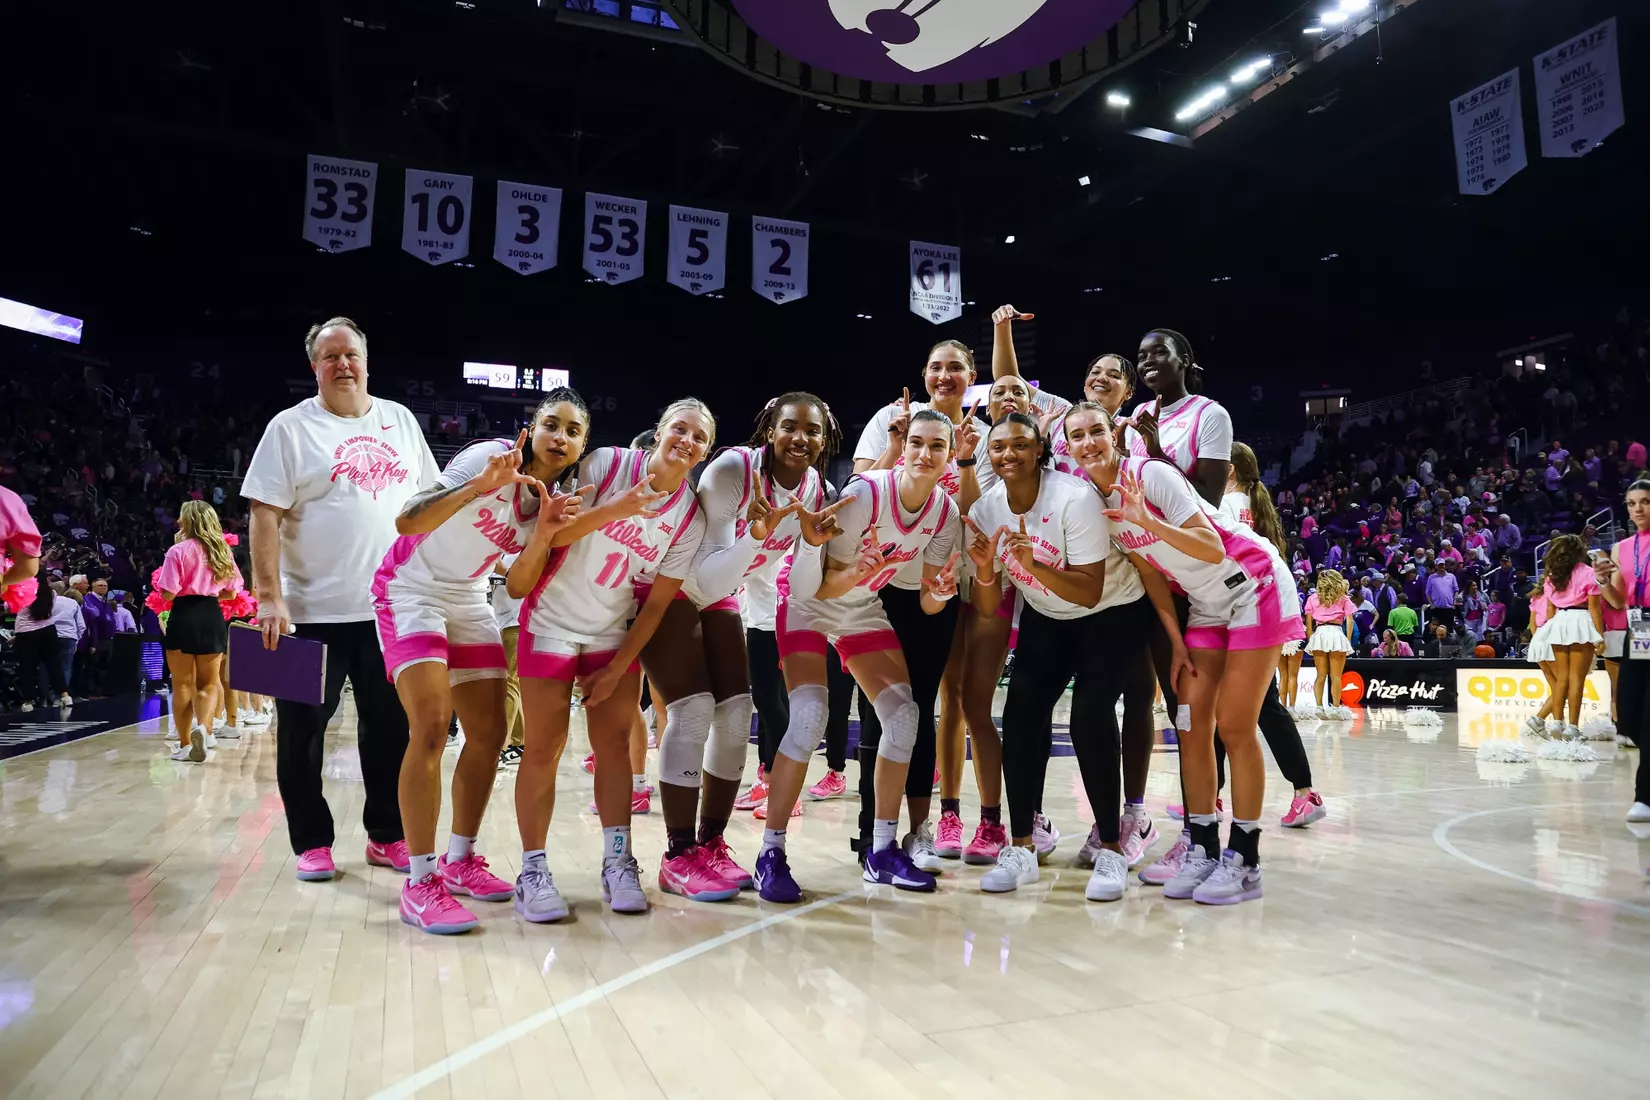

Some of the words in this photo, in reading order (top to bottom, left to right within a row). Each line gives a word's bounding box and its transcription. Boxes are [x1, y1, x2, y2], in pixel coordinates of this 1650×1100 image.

[1541, 27, 1609, 70] K-STATE
[1560, 61, 1593, 84] WNIT
[1457, 77, 1513, 112] K-STATE
[1473, 108, 1500, 127] AIAW
[1552, 125, 1575, 138] 2013
[313, 163, 371, 178] ROMSTAD
[424, 179, 454, 190] GARY
[310, 178, 368, 223] 33
[511, 190, 548, 203] OHLDE
[411, 193, 464, 235] 10
[595, 201, 637, 214] WECKER
[514, 205, 540, 244] 3
[677, 213, 721, 227] LEHNING
[318, 226, 356, 237] 1979-82
[589, 214, 640, 256] 53
[755, 223, 807, 238] CHAMBERS
[417, 239, 454, 250] 1981-83
[686, 228, 709, 266] 5
[508, 249, 544, 260] 2000-04
[768, 238, 791, 276] 2
[913, 247, 941, 259] AYOKA
[942, 252, 958, 261] LEE
[596, 260, 631, 270] 2001-05
[916, 259, 950, 293] 61
[763, 279, 796, 290] 2009-13
[929, 293, 953, 302] DIVISION
[190, 361, 220, 380] 24
[495, 372, 510, 383] 59
[405, 379, 435, 397] 25
[589, 396, 618, 412] 26
[380, 442, 399, 458] SERVE
[1040, 539, 1060, 556] SERVE
[1366, 678, 1408, 699] Pizza
[1409, 680, 1445, 700] Hut
[1467, 675, 1600, 705] QDOA
[1494, 699, 1545, 711] MEXICA
